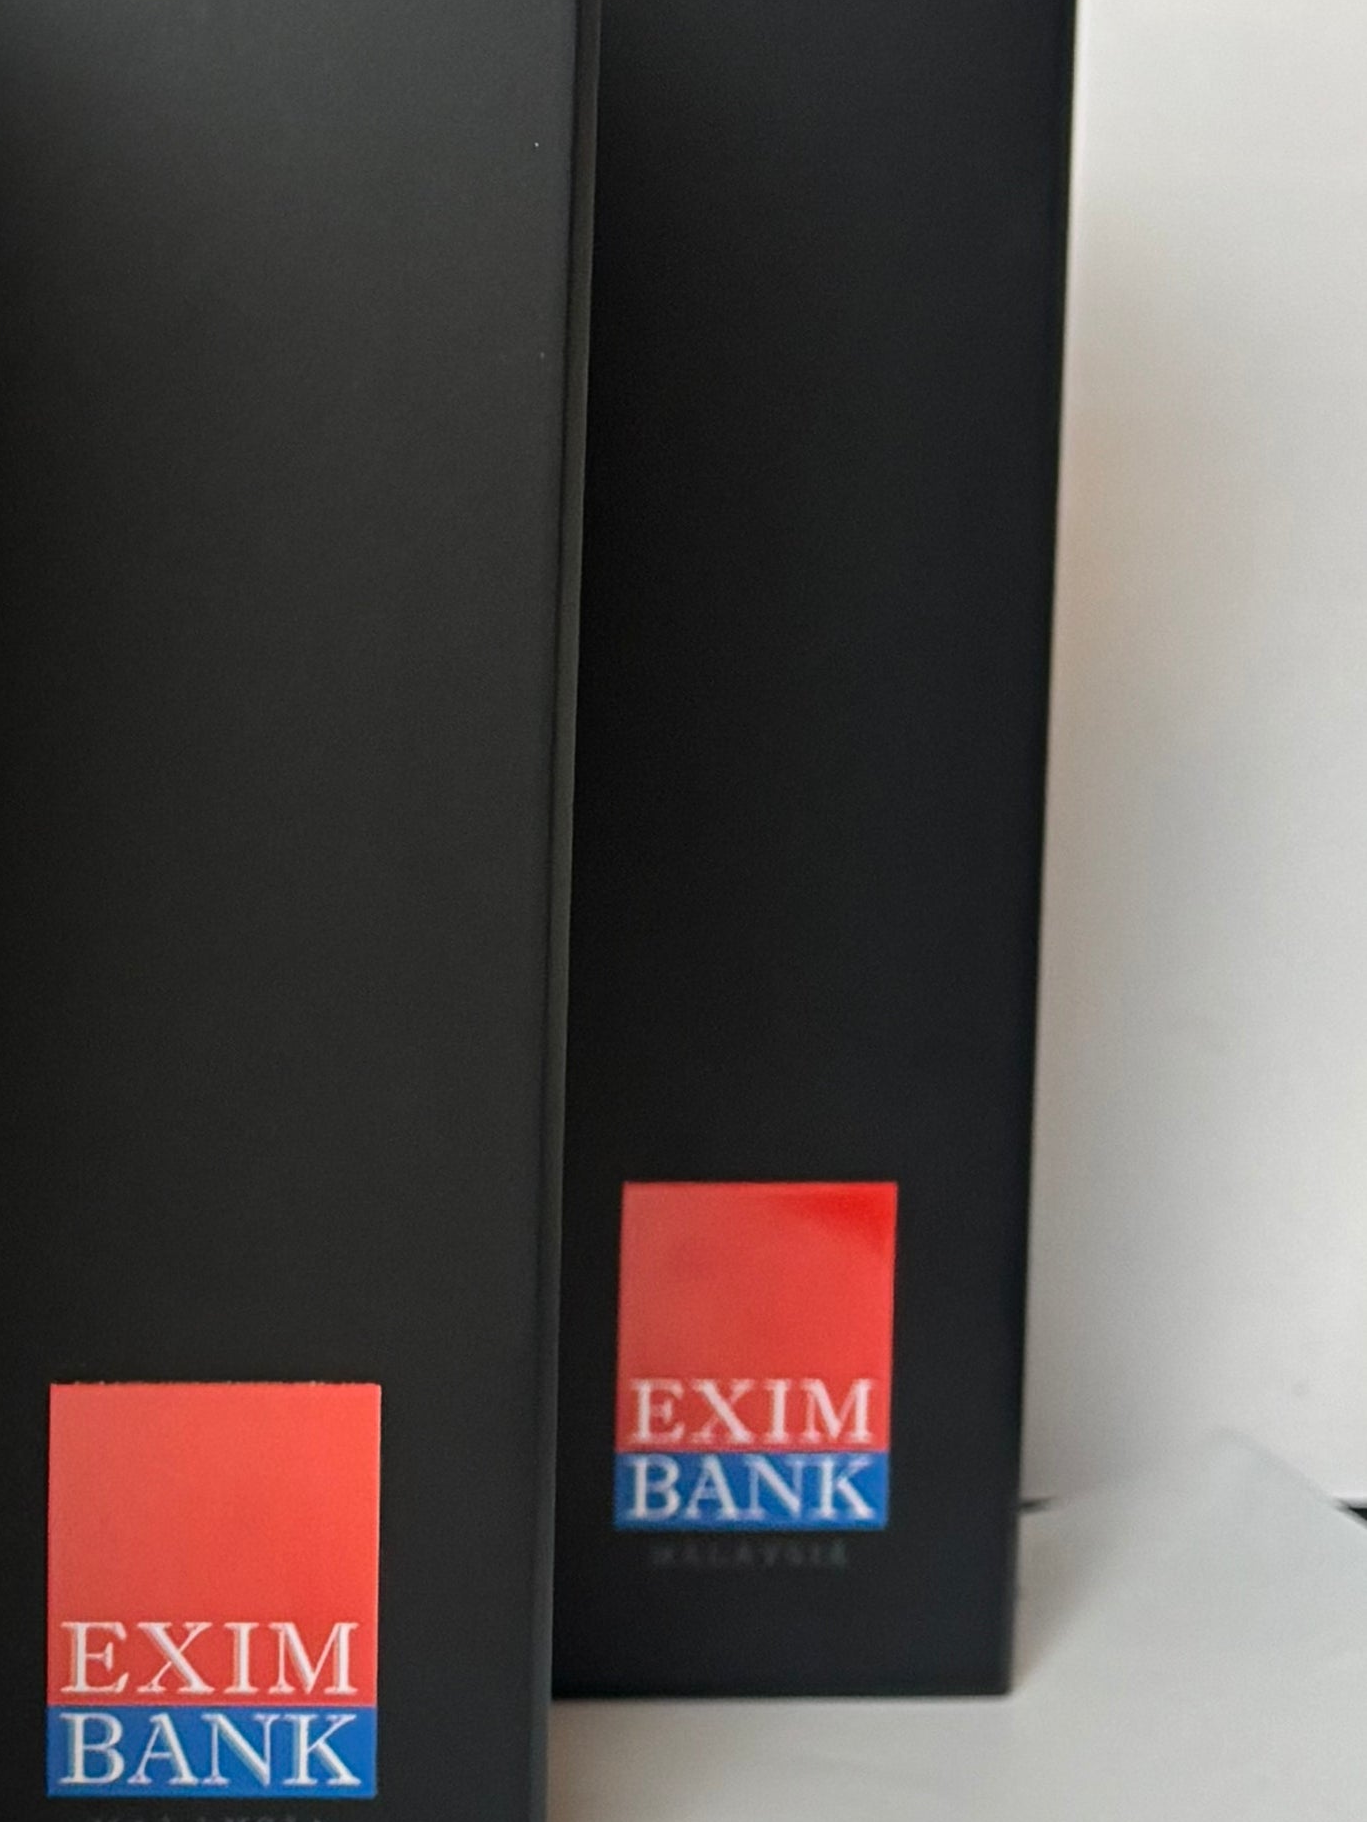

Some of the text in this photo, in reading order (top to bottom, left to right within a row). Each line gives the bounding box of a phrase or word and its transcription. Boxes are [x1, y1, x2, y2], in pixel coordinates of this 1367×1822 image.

[631, 1377, 872, 1445] EXIM
[627, 1453, 874, 1520] BANK
[60, 1621, 360, 1695] EXIM
[58, 1712, 361, 1787] BANK
